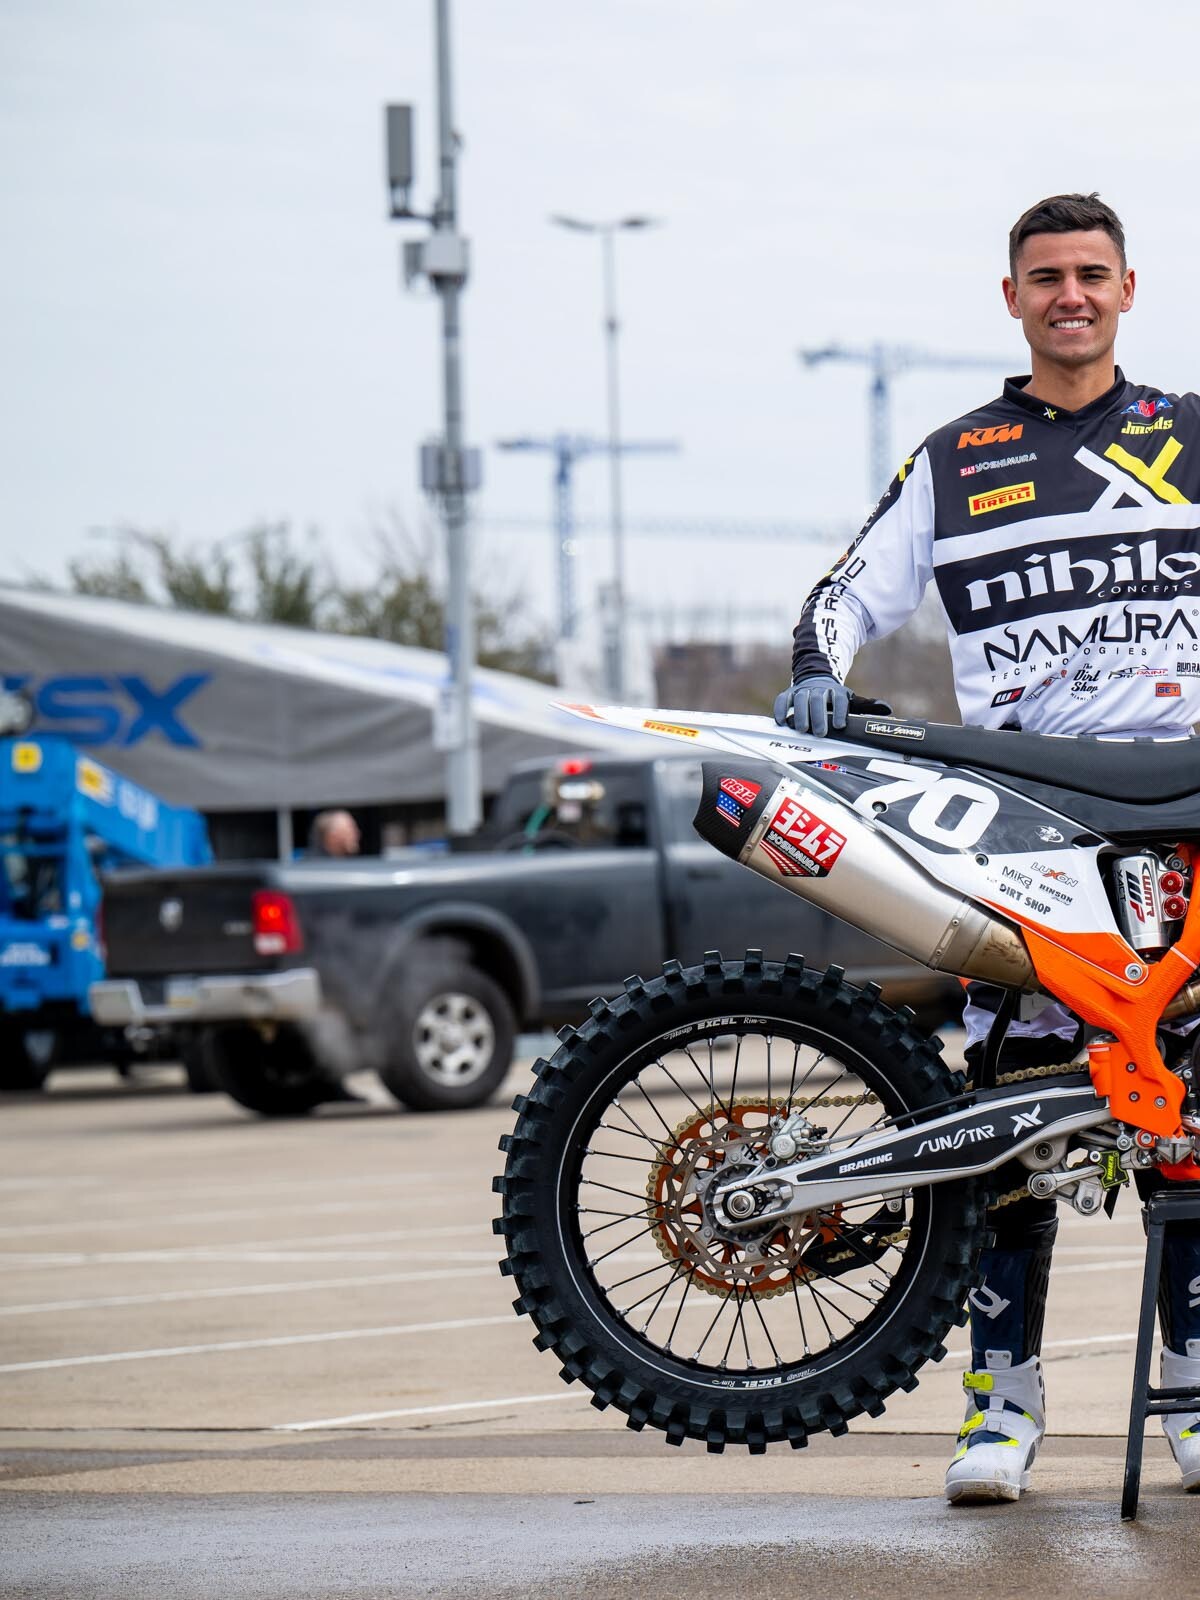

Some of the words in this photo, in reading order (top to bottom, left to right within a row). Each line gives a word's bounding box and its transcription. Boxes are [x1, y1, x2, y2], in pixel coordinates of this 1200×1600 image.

[957, 423, 1024, 449] KTM
[975, 452, 1037, 473] YOSHIMURA
[973, 486, 1030, 511] PIRELLI
[1098, 580, 1192, 598] CONCEPTS
[984, 604, 1198, 671] NAMURA
[991, 647, 1147, 682] TECHNOOGIES
[1165, 643, 1198, 651] INC
[1073, 670, 1101, 681] Dirt
[1071, 682, 1098, 693] Shop
[0, 673, 214, 748] SX
[720, 778, 757, 804] RS12
[852, 759, 1000, 848] 70
[767, 830, 821, 876] YOSHIMURA
[1031, 862, 1079, 888] LUXON
[999, 883, 1023, 901] DIRT
[1024, 897, 1051, 915] SHOP
[1039, 883, 1073, 903] HINSON
[698, 1018, 737, 1030] EXCEL
[914, 1124, 995, 1158] SUNSTAR
[839, 1152, 893, 1174] BRAKING
[742, 1377, 782, 1388] EXCEL
